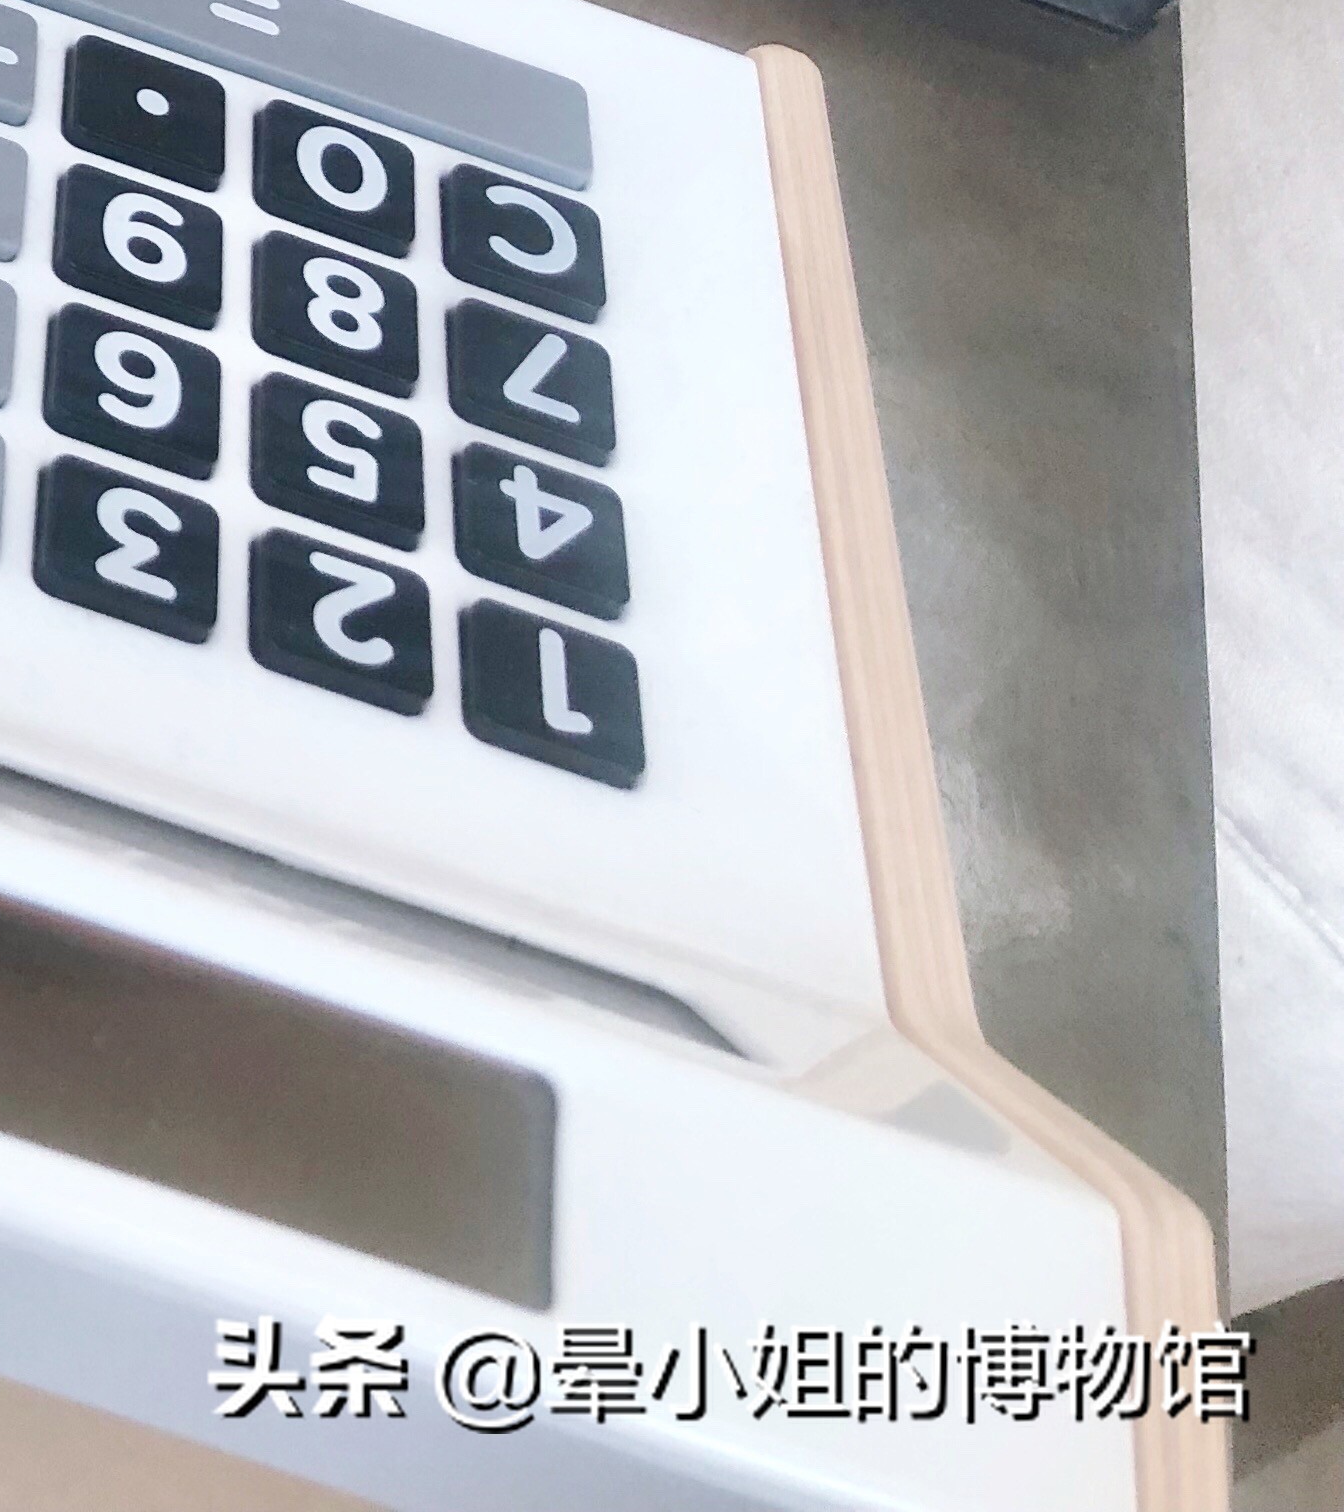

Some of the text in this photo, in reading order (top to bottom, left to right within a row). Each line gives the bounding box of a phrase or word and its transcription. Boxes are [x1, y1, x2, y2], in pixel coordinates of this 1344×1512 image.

[303, 256, 385, 350] 8
[302, 399, 382, 503] 5
[95, 487, 182, 602] 3
[499, 465, 593, 561] 4
[309, 551, 395, 666] 2
[539, 626, 593, 735] 1
